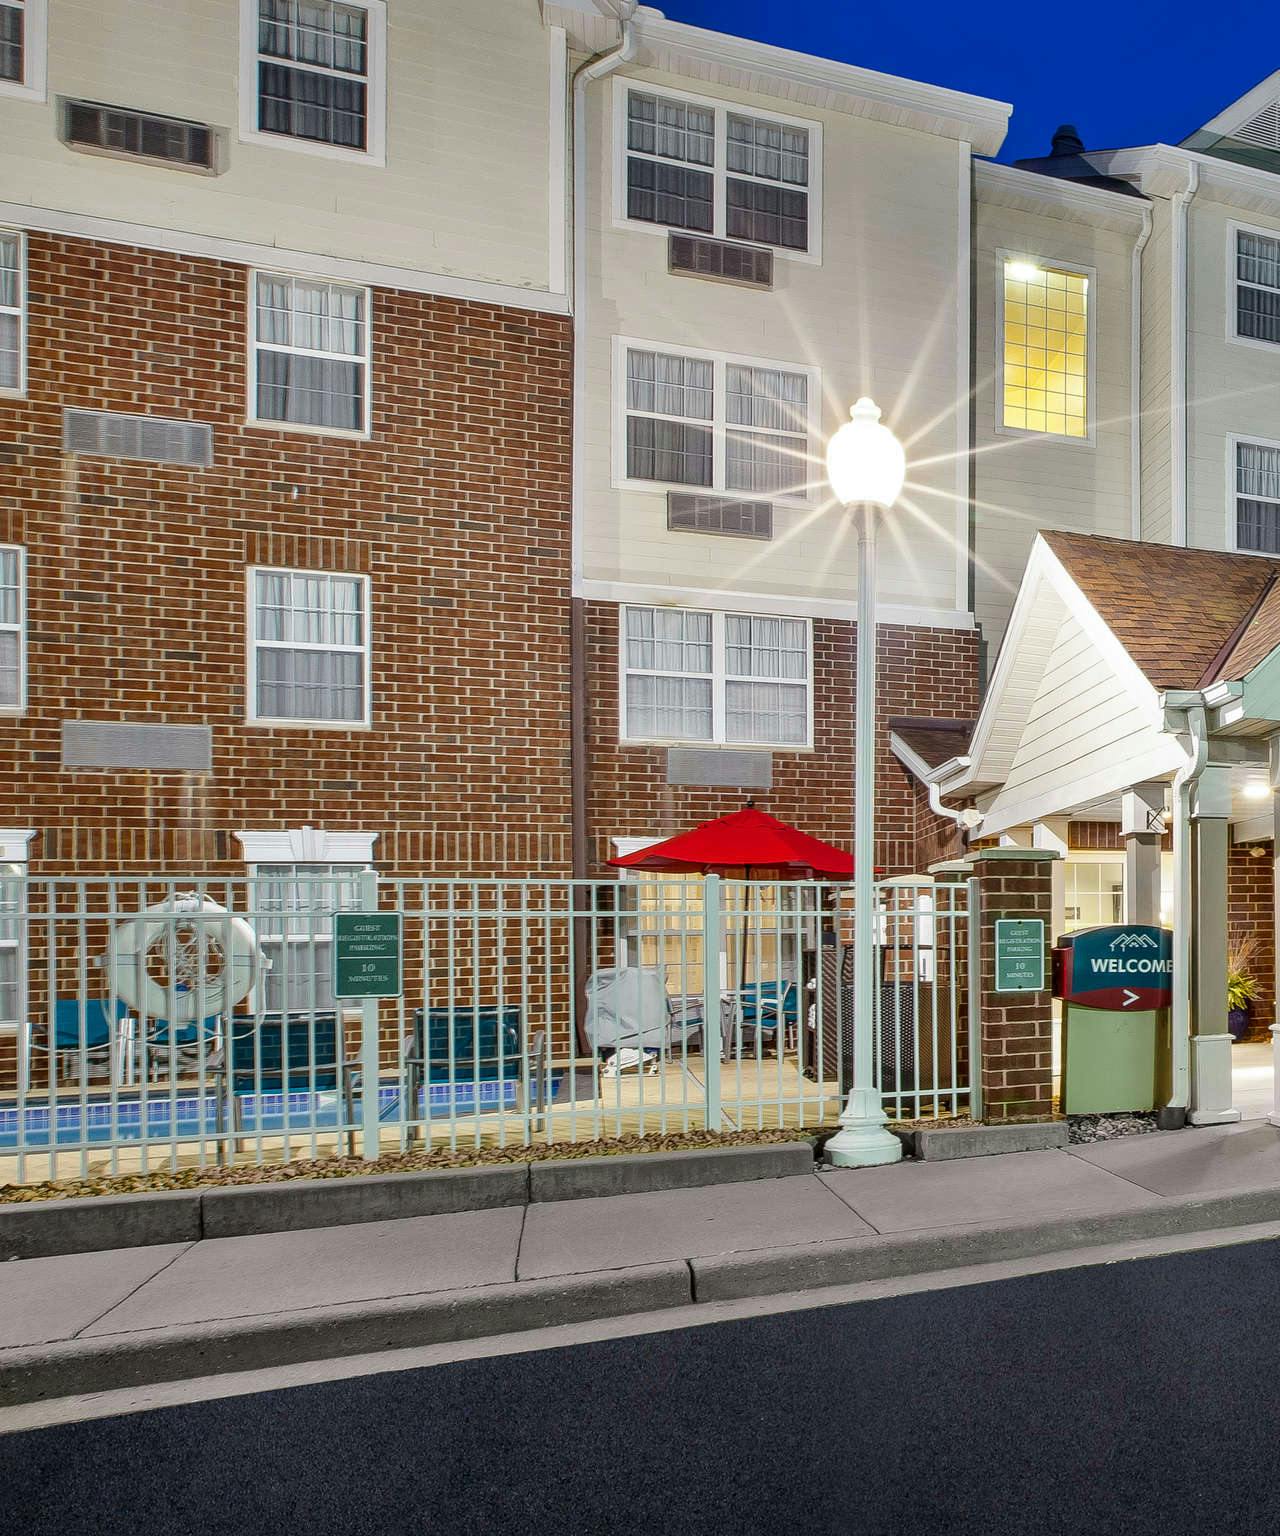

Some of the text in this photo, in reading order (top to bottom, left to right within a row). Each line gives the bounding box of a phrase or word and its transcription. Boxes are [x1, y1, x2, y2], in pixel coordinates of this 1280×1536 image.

[361, 964, 376, 972] 10
[1015, 962, 1025, 970] 10
[1090, 958, 1173, 973] WELCOME
